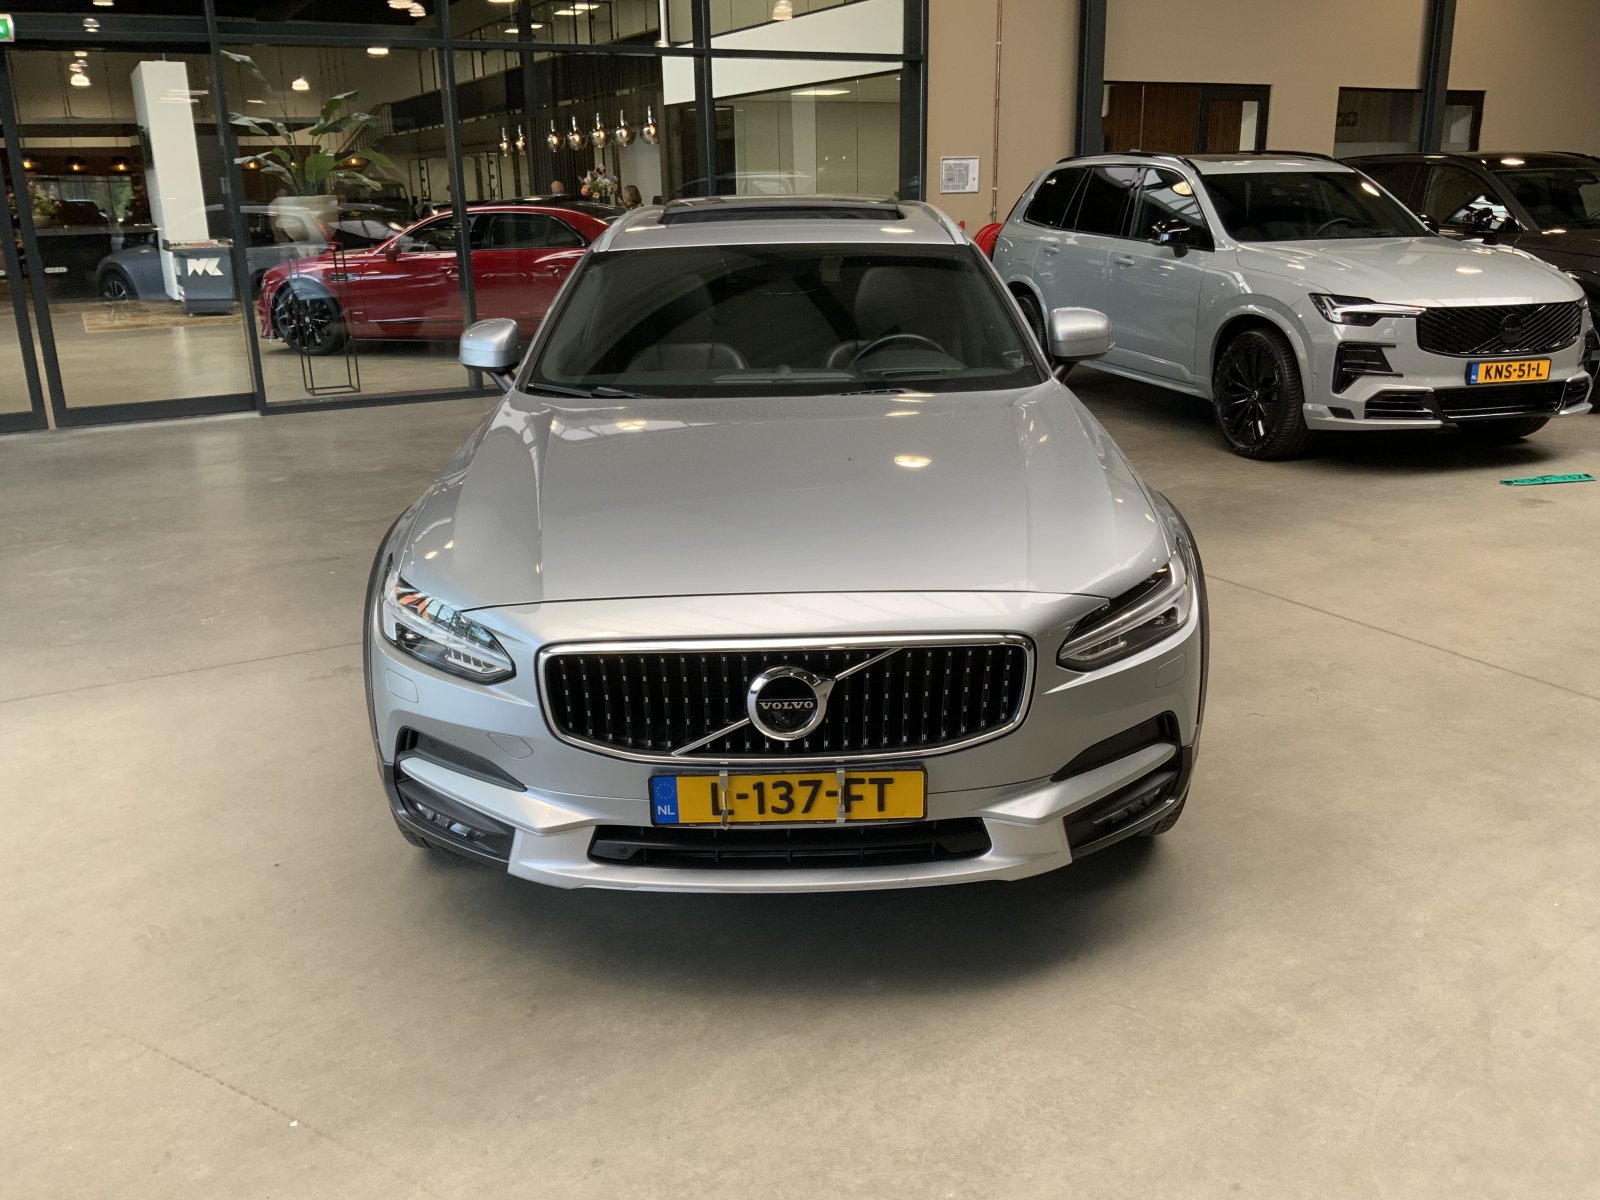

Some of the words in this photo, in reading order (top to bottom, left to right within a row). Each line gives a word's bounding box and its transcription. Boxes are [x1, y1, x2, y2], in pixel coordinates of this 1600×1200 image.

[1484, 362, 1543, 380] KNS-51-L
[759, 701, 814, 710] VOLVO
[657, 805, 676, 816] NL
[711, 777, 894, 816] L-137-FT
